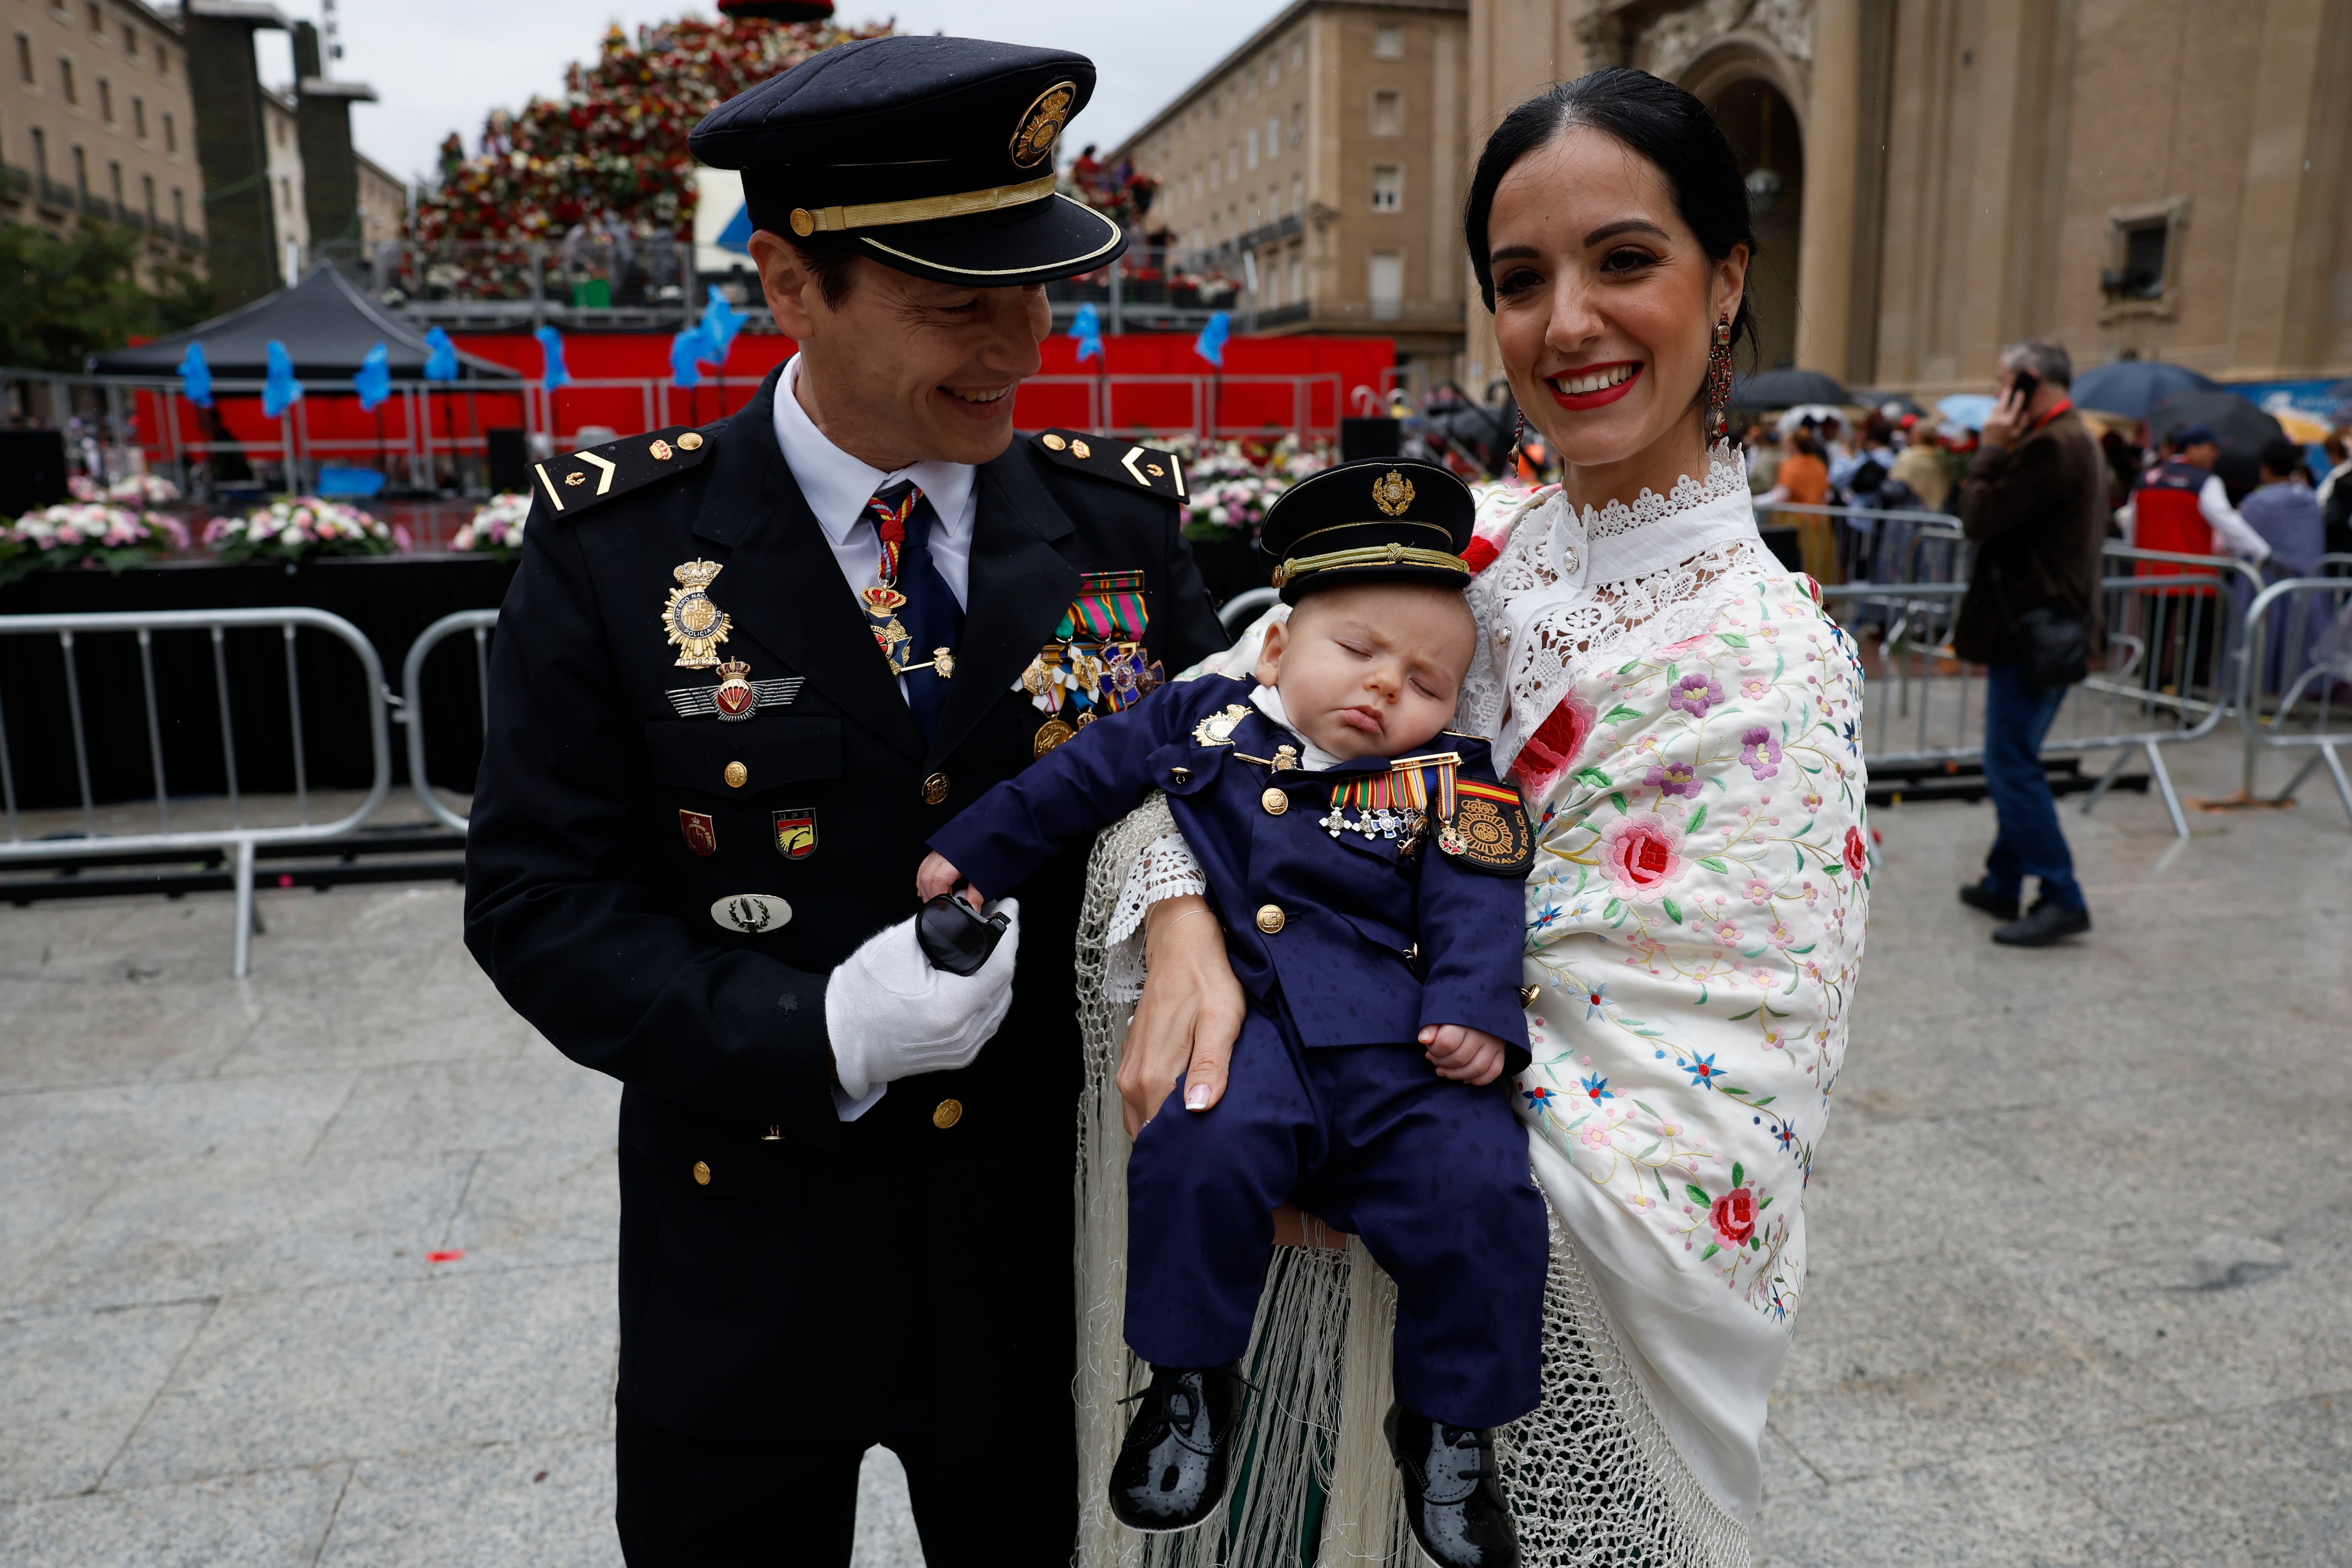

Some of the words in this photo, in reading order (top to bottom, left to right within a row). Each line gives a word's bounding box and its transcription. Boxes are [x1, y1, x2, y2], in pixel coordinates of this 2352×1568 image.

[675, 597, 690, 620] CUERPO
[684, 628, 712, 637] POLICIA
[872, 626, 892, 645] RISTOBAL
[680, 657, 717, 666] 077823
[1514, 809, 1529, 847] POLICIA
[1465, 851, 1517, 864] CIONAL
[1514, 847, 1528, 861] DE
